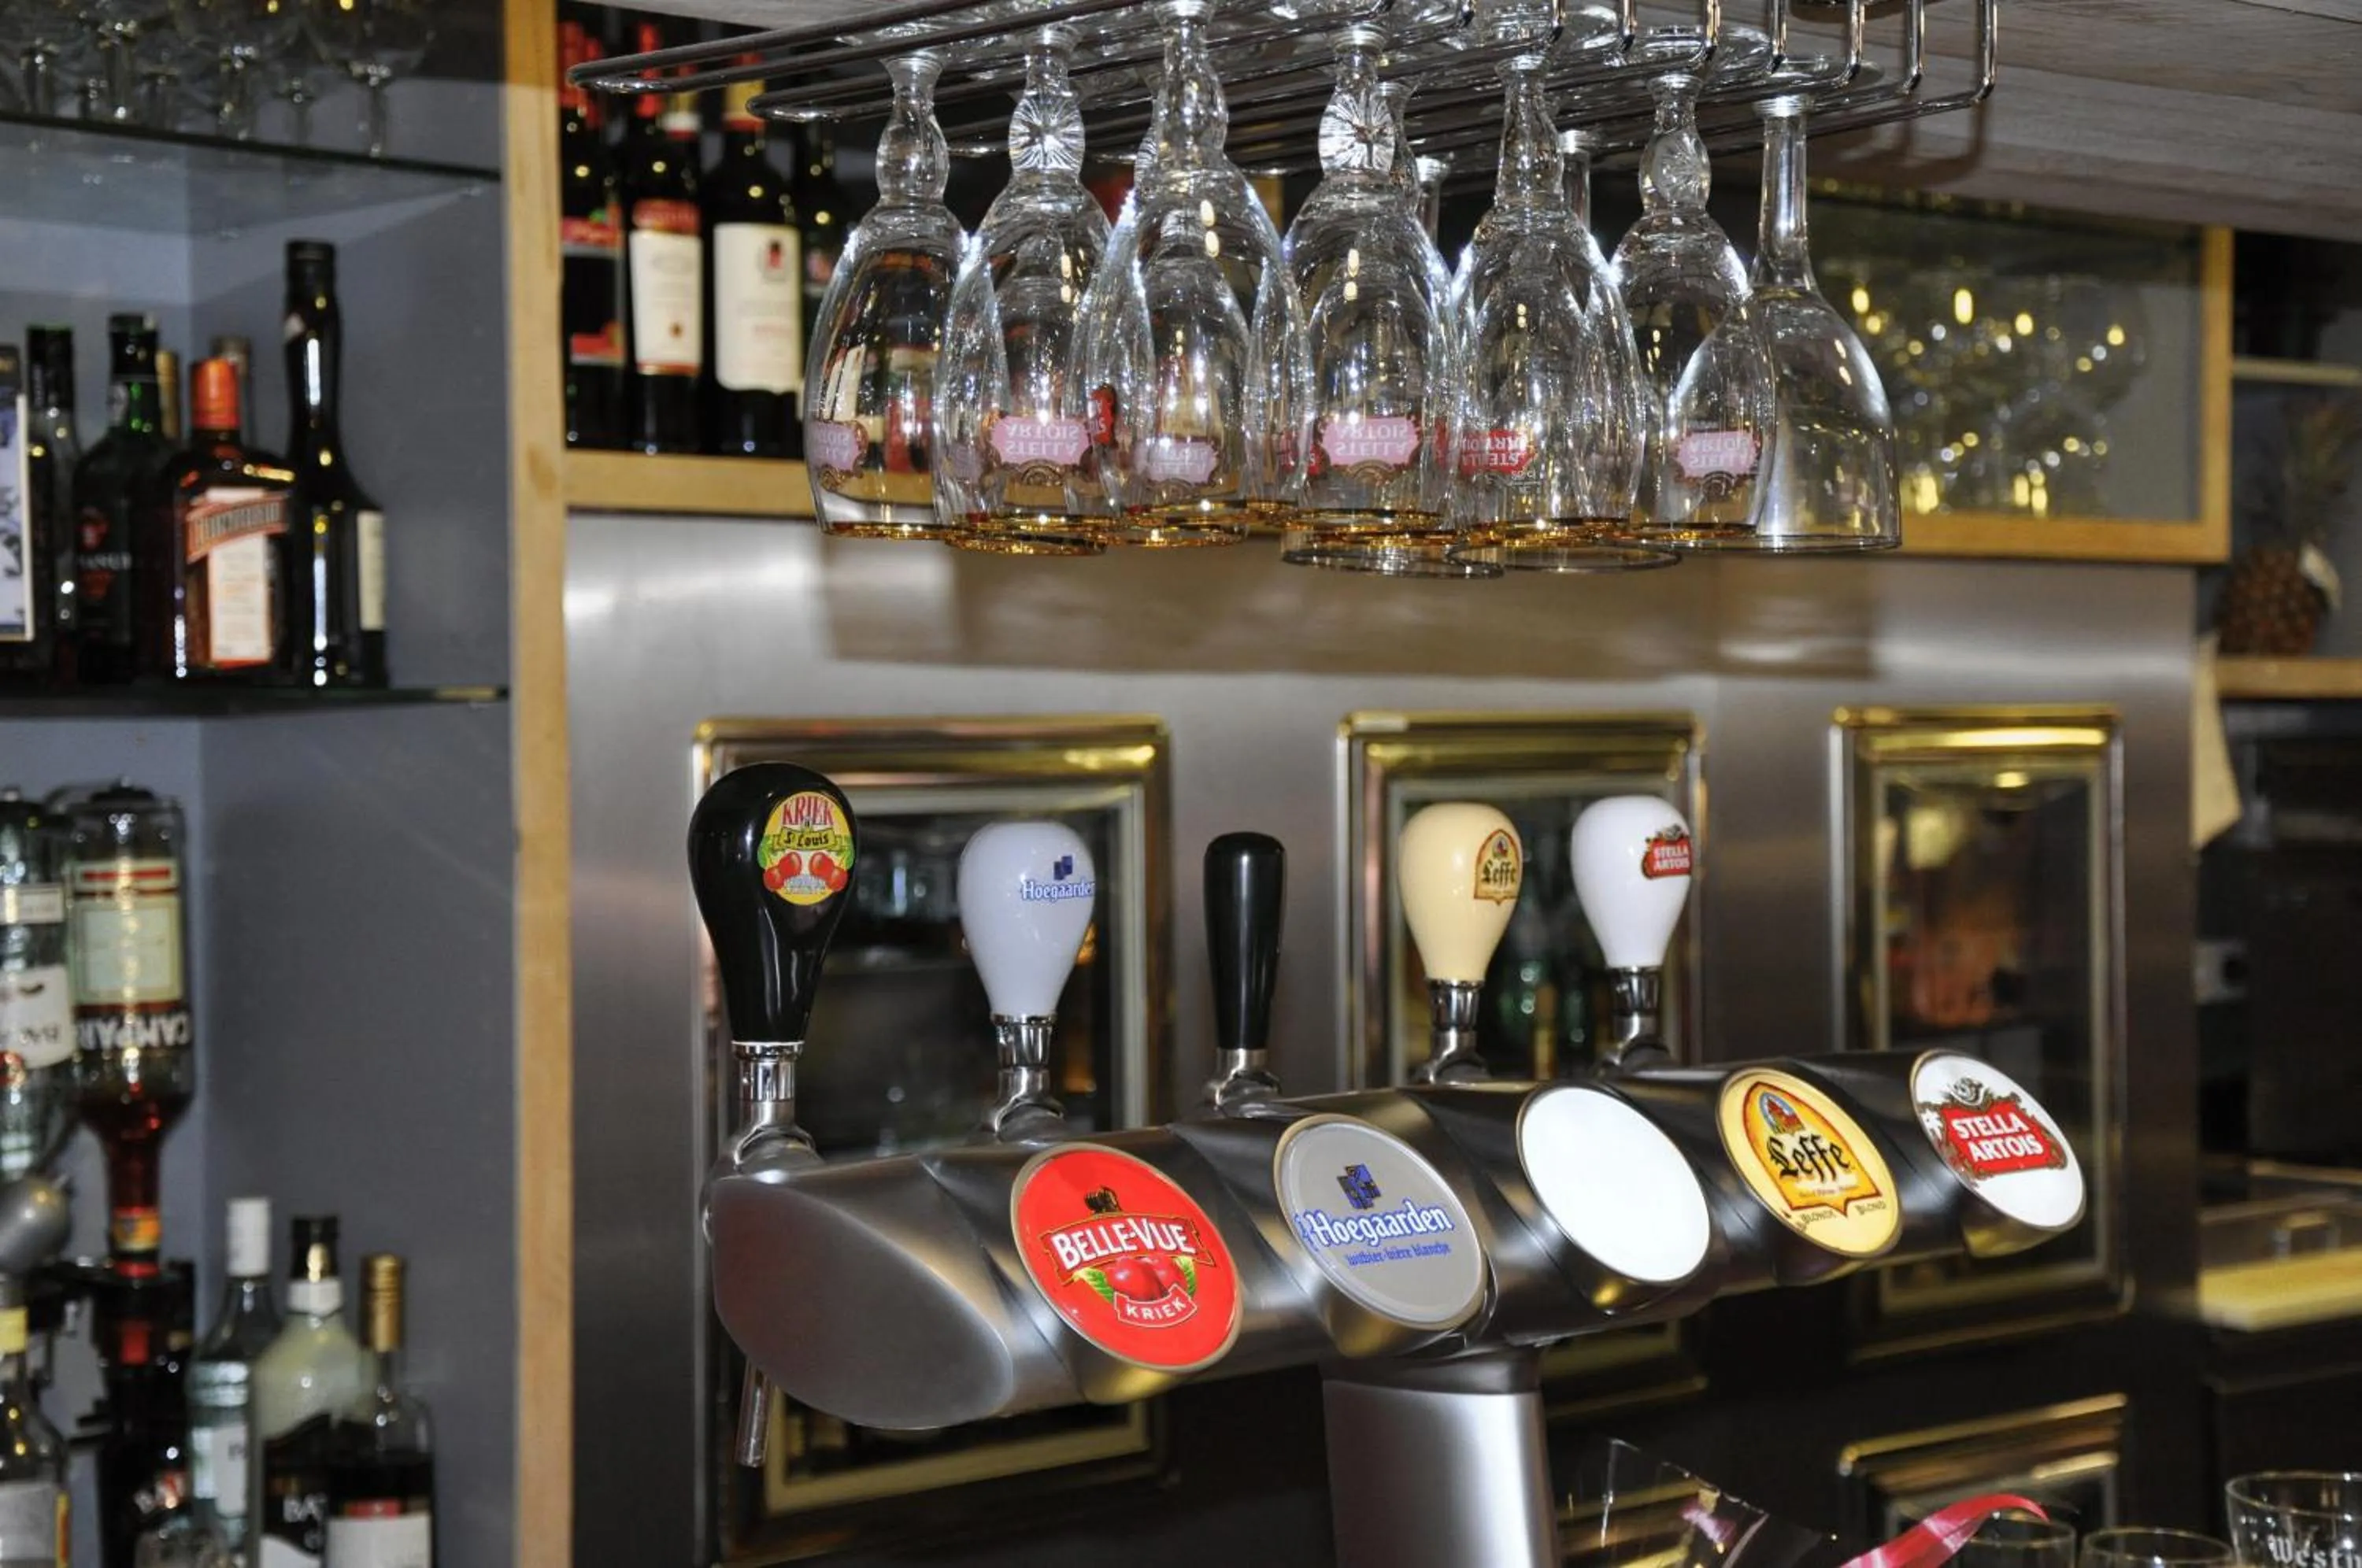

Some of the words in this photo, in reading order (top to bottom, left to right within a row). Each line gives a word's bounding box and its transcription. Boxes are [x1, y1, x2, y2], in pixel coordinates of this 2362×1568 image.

[782, 796, 834, 826] KRIEK
[797, 833, 830, 847] Louis
[77, 1012, 190, 1052] CAMPAR
[1951, 1111, 2031, 1140] STELLA
[1766, 1132, 1851, 1184] Leffe
[1967, 1133, 2045, 1163] ARTOIS
[1304, 1196, 1455, 1248] Hoegaarden
[1051, 1217, 1197, 1271] BELLE-VUE
[1124, 1297, 1187, 1322] KRIEK
